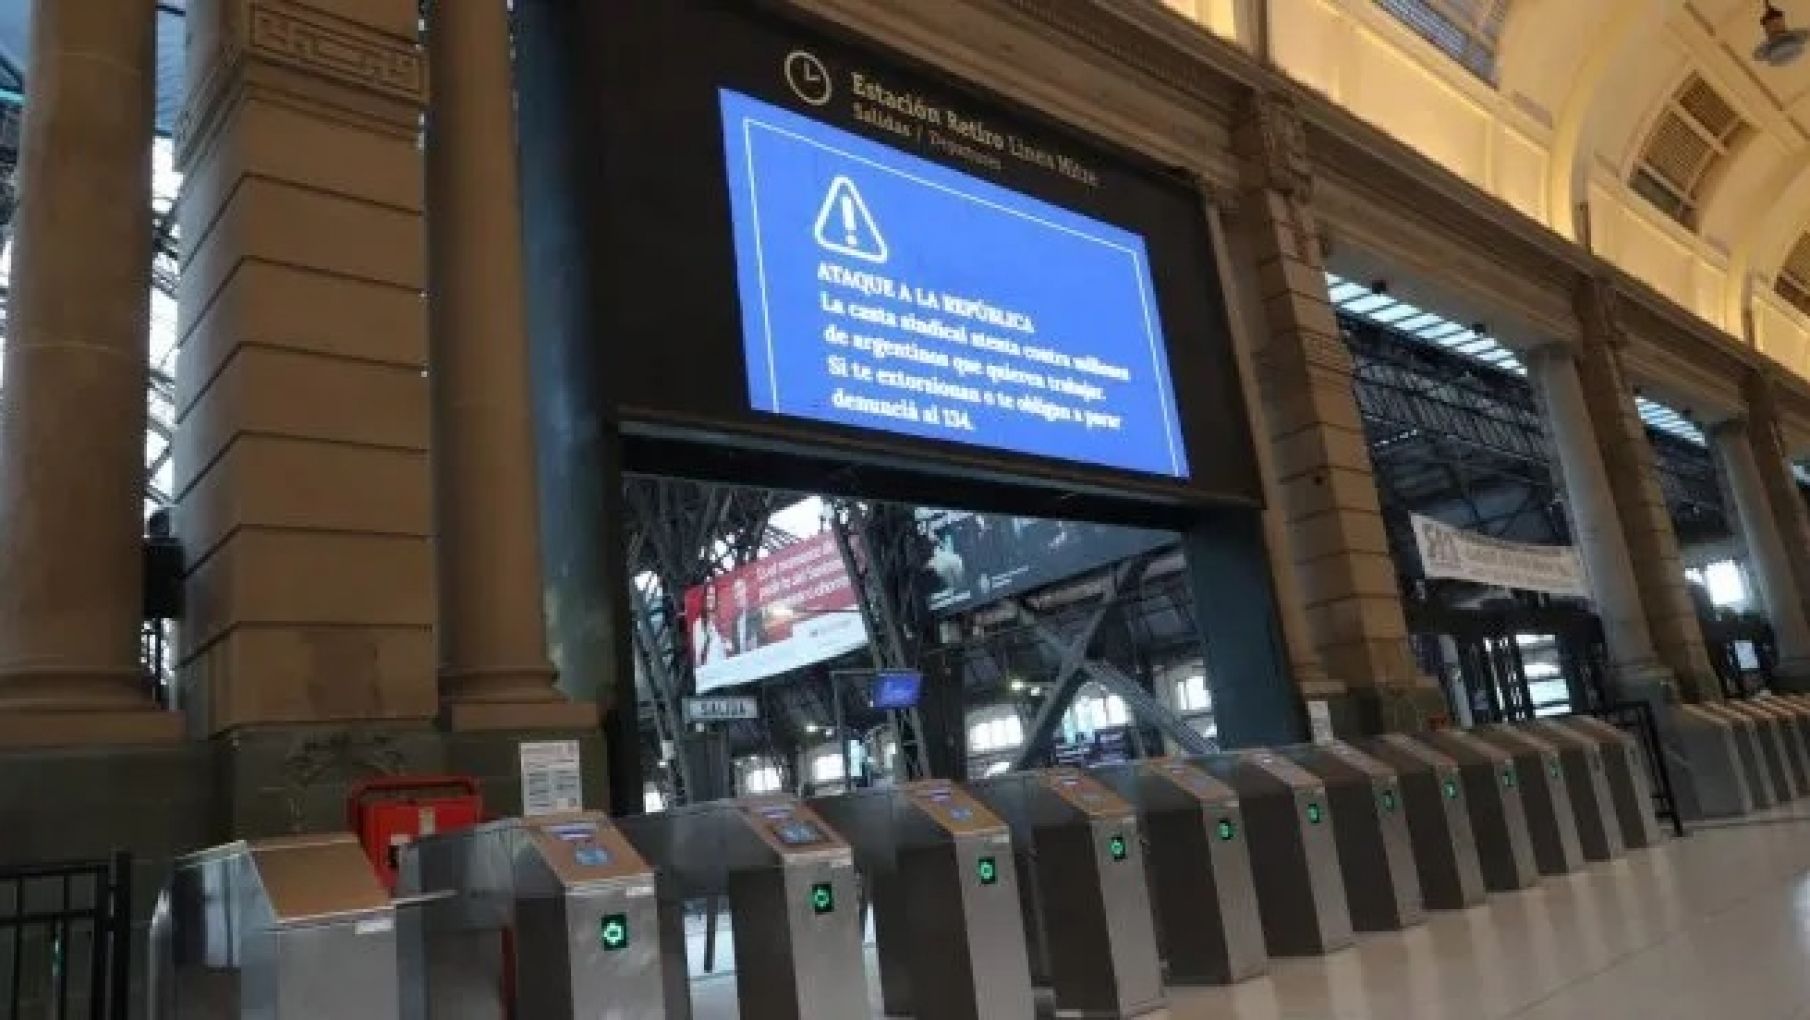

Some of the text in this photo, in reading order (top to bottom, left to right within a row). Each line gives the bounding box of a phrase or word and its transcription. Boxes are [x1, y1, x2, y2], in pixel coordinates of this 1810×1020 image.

[851, 71, 942, 126] Estación
[946, 109, 1004, 151] Retiro
[853, 101, 912, 138] Salidas
[817, 262, 1035, 333] ATAQUE A LA REPÚBLICA
[820, 292, 846, 315] La
[847, 304, 898, 328] casta
[900, 314, 968, 344] sindical
[1022, 346, 1072, 368] contra
[824, 324, 849, 346] de
[853, 335, 950, 367] argentinos
[952, 356, 984, 377] que
[986, 363, 1047, 389] quieren
[828, 354, 849, 378] Si
[850, 362, 874, 382] te
[875, 369, 983, 403] extorsionan
[983, 390, 996, 406] o
[997, 391, 1016, 409] te
[1016, 394, 1072, 422] obligan
[922, 404, 941, 426] al
